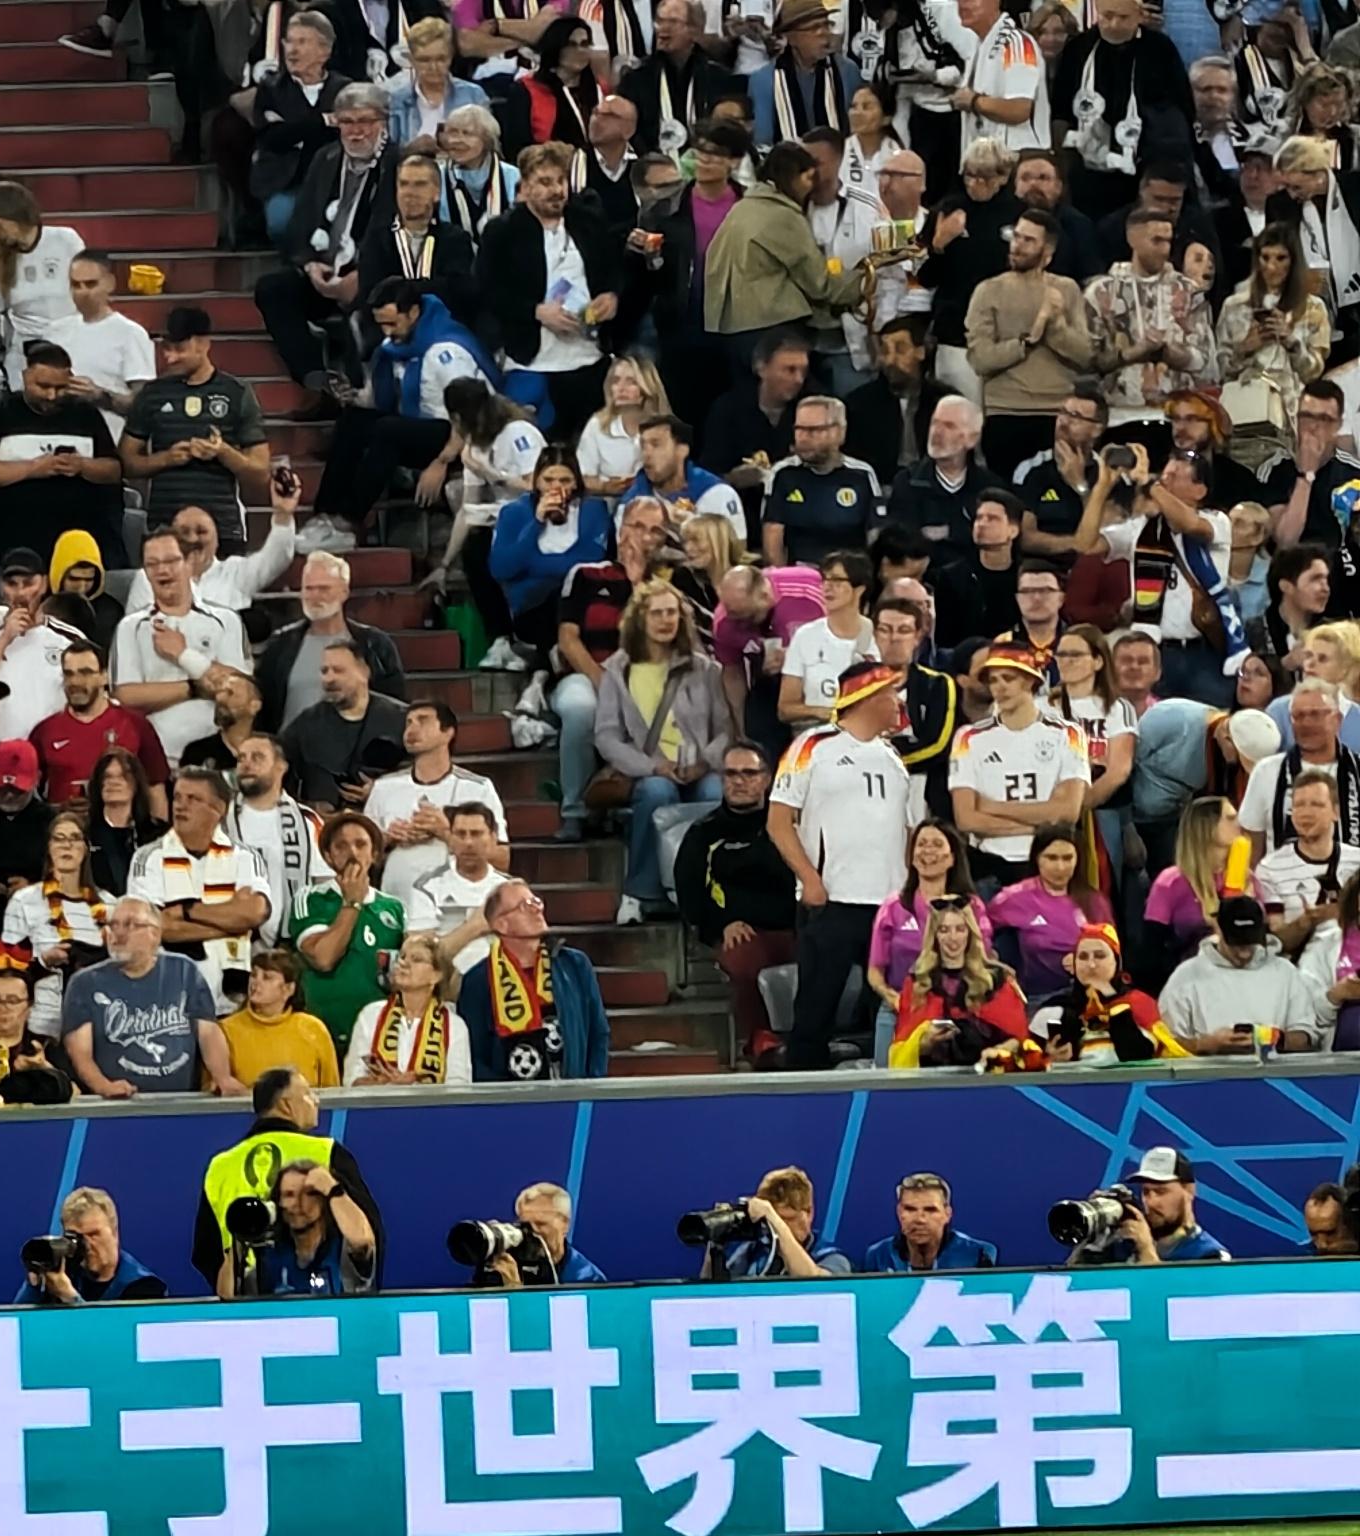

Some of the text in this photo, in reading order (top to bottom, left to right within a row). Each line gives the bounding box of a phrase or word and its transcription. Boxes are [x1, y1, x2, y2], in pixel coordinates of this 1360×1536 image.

[862, 771, 886, 800] 11
[1004, 772, 1038, 802] 23
[363, 925, 376, 946] 6
